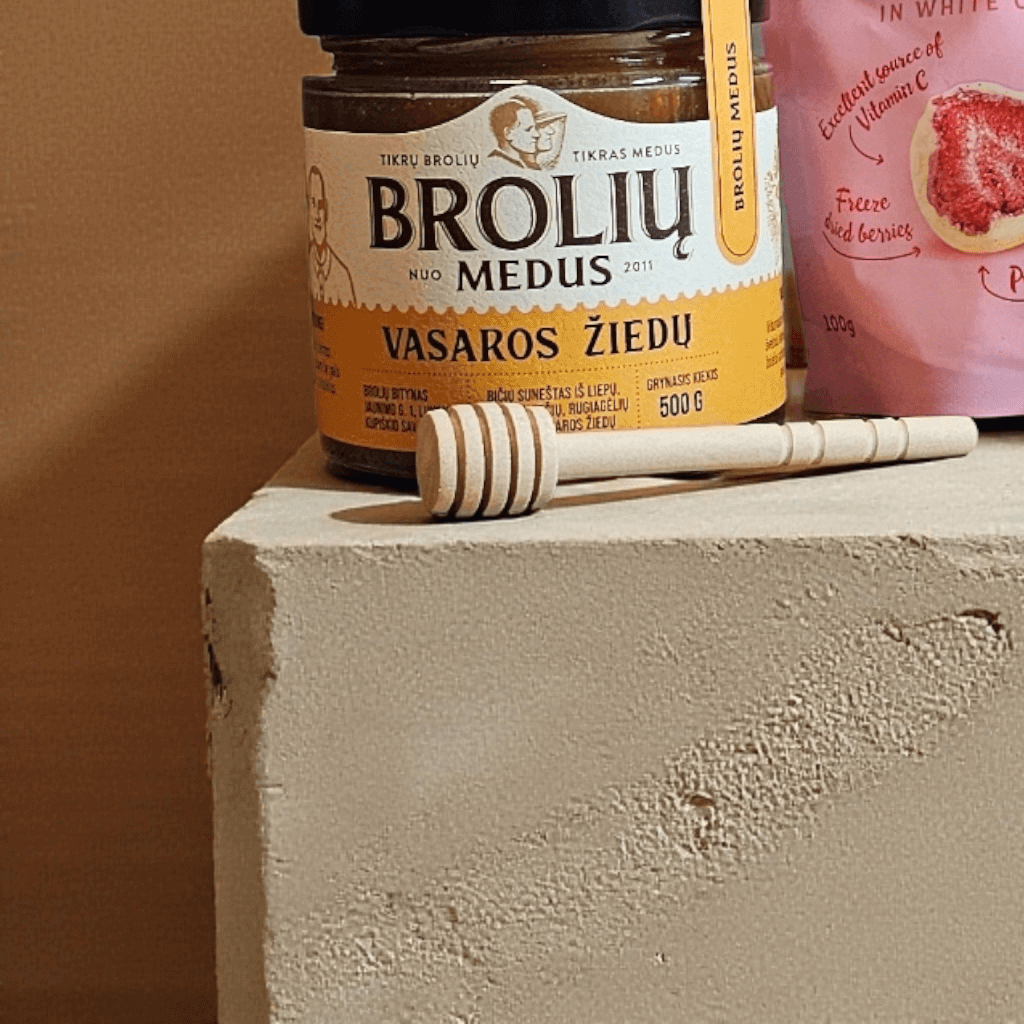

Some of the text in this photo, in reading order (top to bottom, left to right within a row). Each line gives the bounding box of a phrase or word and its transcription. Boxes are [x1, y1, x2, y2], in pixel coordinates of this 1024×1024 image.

[880, 3, 901, 23] IN
[818, 31, 944, 141] Excellent source of
[855, 69, 929, 131] Vitamin C
[725, 41, 746, 212] BROLIŲ MEDUS
[380, 152, 480, 168] TIKRŲ BROLIŲ
[572, 144, 681, 162] TIKRAS MEDUS
[365, 165, 696, 260] BROLIŲ
[836, 187, 890, 212] Freeze
[824, 211, 913, 243] dried berries
[408, 255, 654, 292] NUO MEDUS 2011
[382, 312, 693, 362] VASAROS ŽIEDŲ
[823, 314, 856, 338] 100g
[517, 385, 571, 401] SUNEŠTAS
[574, 382, 585, 398] IŠ
[647, 372, 691, 392] GRYNASIS
[659, 390, 703, 418] 500 G
[586, 415, 616, 430] ŽIEDŲ
